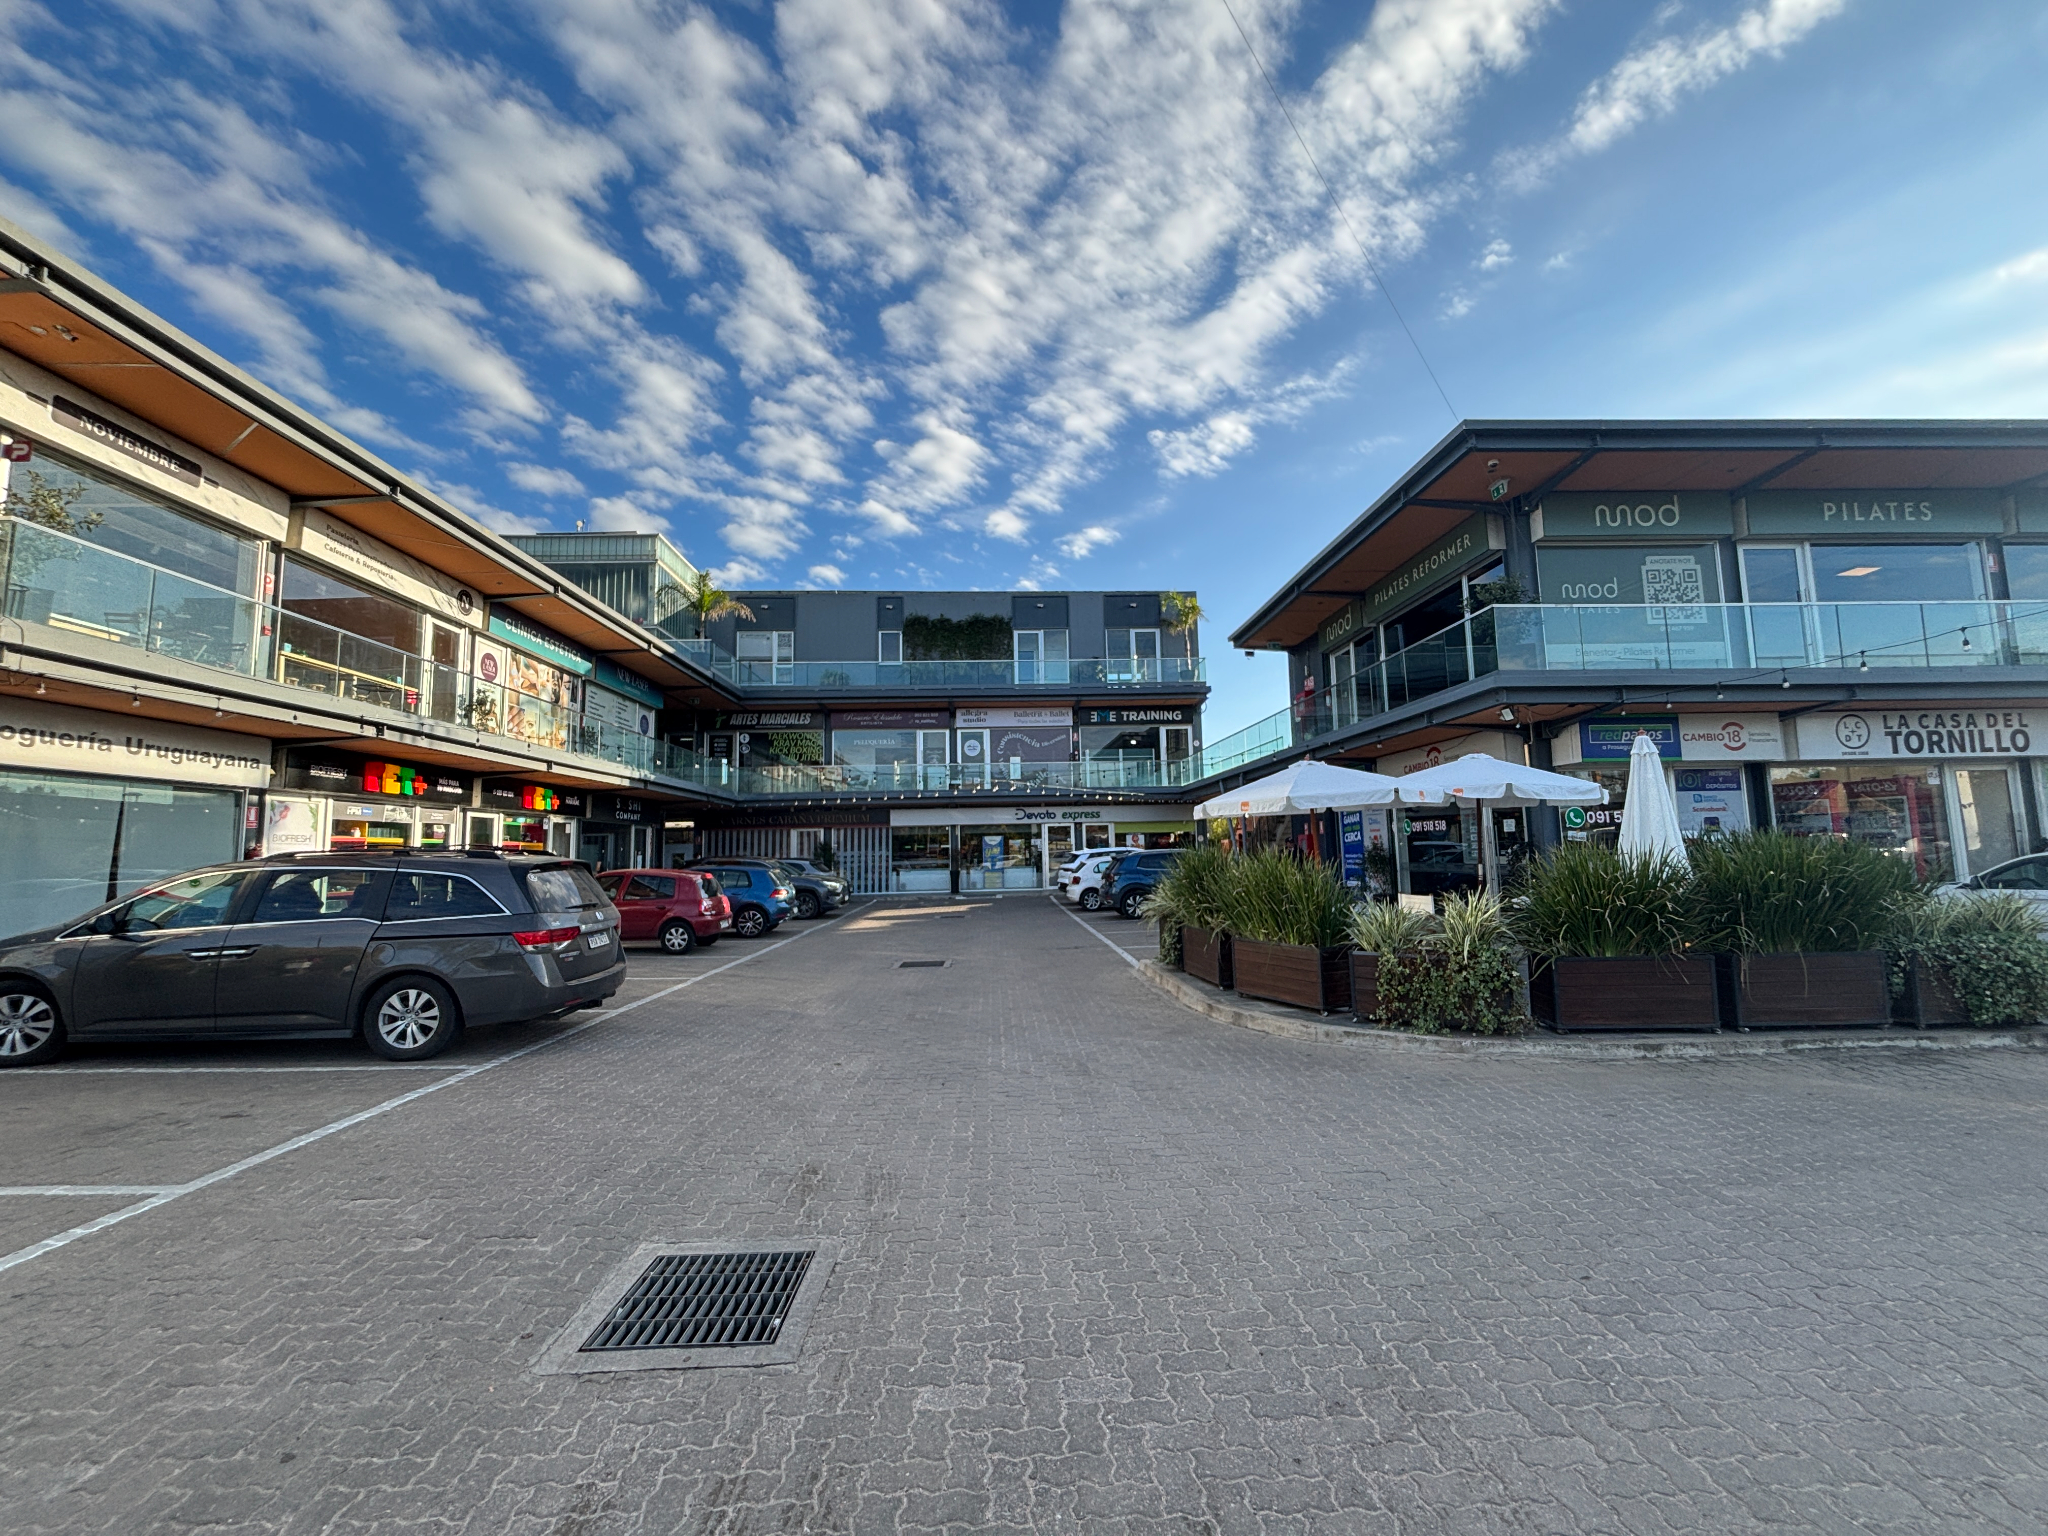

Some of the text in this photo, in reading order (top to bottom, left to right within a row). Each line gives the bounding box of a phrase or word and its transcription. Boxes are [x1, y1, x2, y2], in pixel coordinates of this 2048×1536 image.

[79, 415, 181, 473] NOVIEMBRE
[1594, 494, 1680, 527] mod
[1823, 502, 1933, 521] PILATES
[1374, 533, 1472, 606] PILATES REFORMER
[1561, 577, 1618, 599] mod
[1326, 606, 1352, 642] mod
[544, 636, 582, 664] ESTÉTICA
[1575, 648, 1617, 657] Benestar
[1654, 646, 1697, 656] Reormer
[730, 712, 812, 725] ARTES MARCIALES
[961, 709, 988, 717] allegra
[1049, 709, 1070, 717] Ballet
[1121, 711, 1183, 721] TRAINING
[1882, 712, 2029, 730] LA CASA DEL
[1600, 727, 1664, 743] redpaos
[1682, 730, 1742, 743] CAMBIO 18
[1884, 728, 2031, 755] TORNILLO
[125, 736, 261, 770] Uruguayana
[616, 797, 642, 812] SSHI
[615, 811, 642, 821] COMPANY
[816, 813, 871, 824] PREMIUM
[1015, 808, 1101, 821] Devoto express
[1587, 810, 1610, 824] 091
[1411, 820, 1447, 832] 091 518 518
[1344, 831, 1362, 843] CERCA
